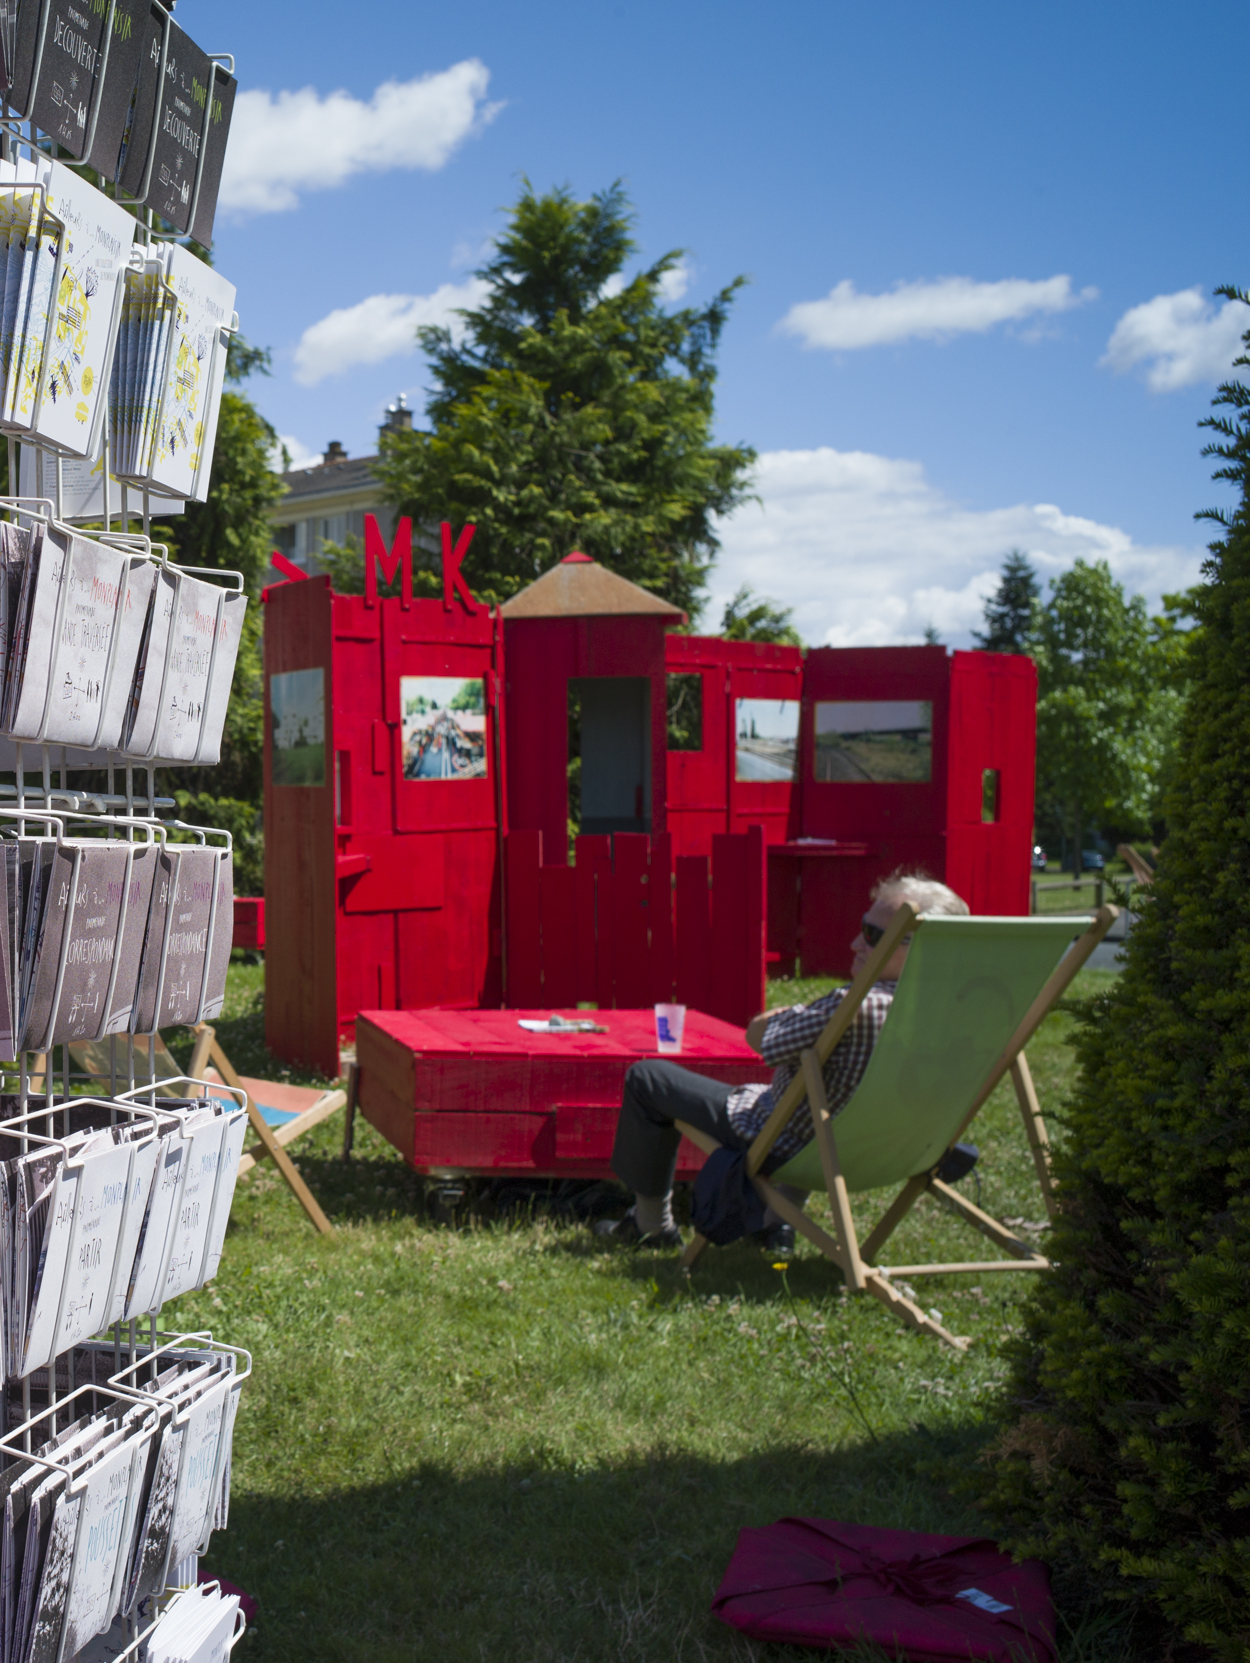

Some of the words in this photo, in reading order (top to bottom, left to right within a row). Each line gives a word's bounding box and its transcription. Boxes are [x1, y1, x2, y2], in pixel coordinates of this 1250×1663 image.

[163, 104, 201, 159] DECOUVERTE
[180, 1201, 200, 1231] PARTIR
[78, 1237, 102, 1271] PARTIR
